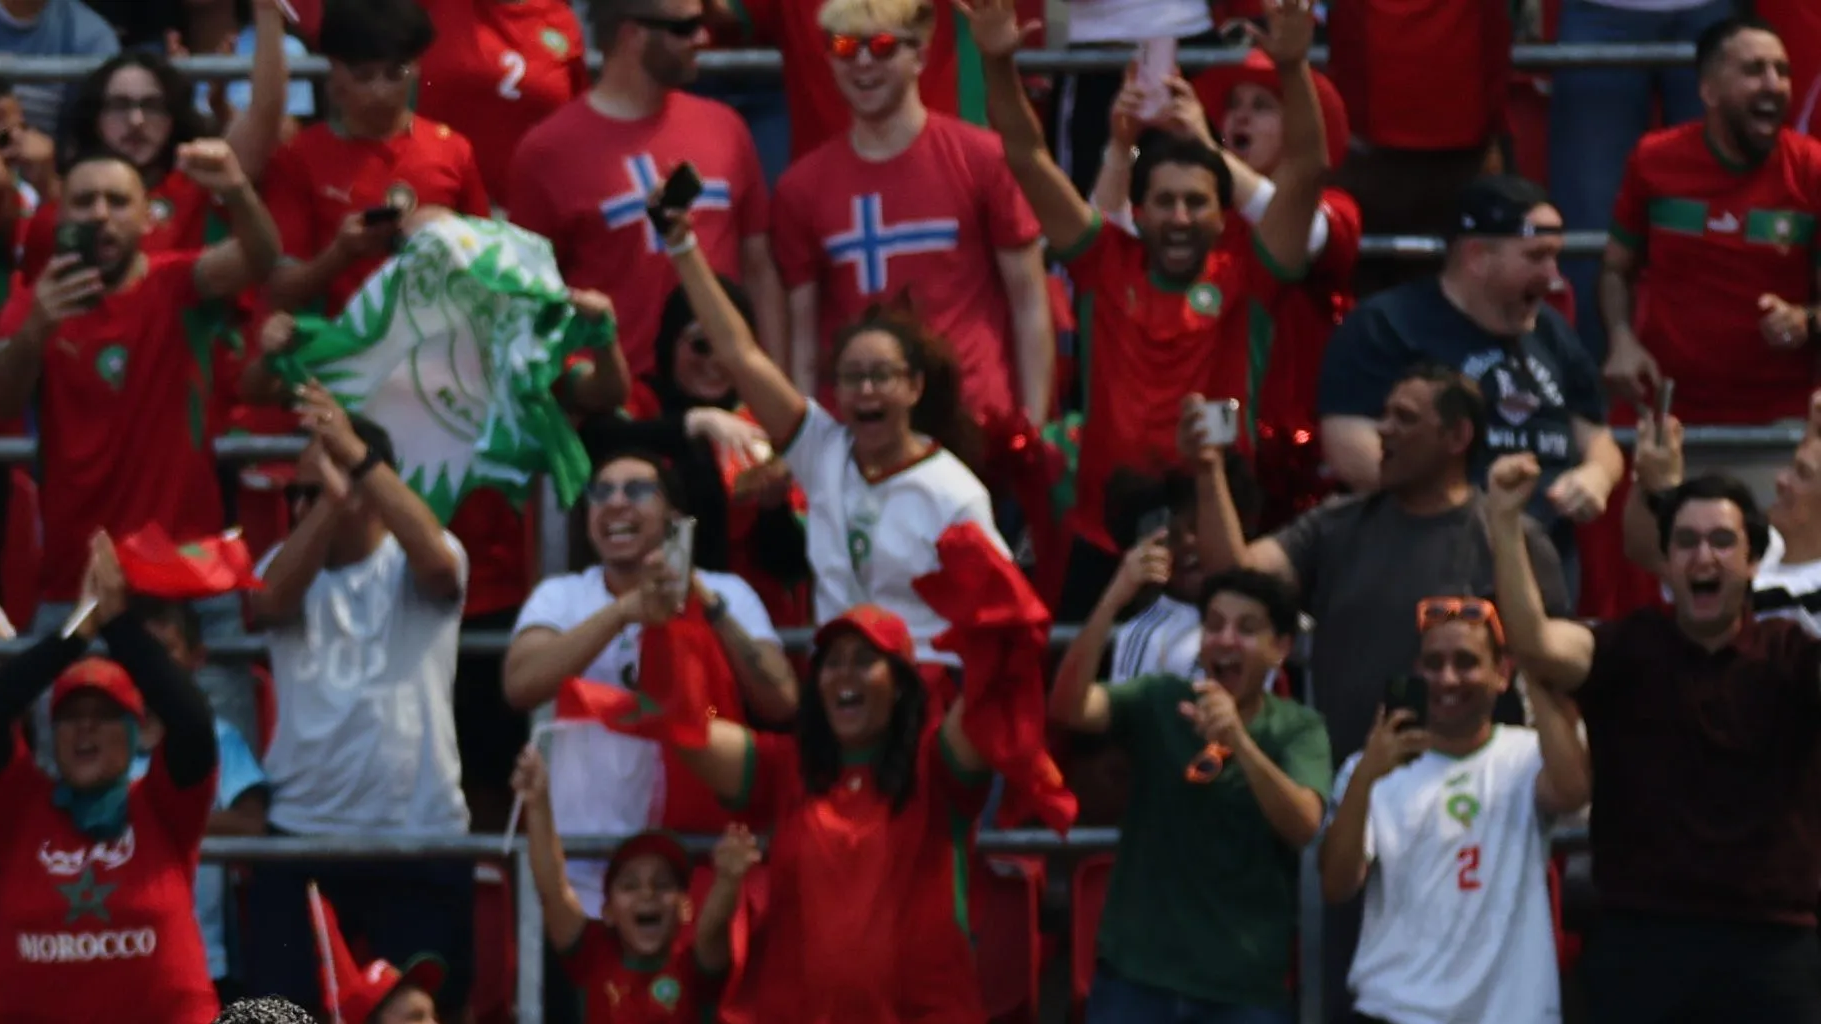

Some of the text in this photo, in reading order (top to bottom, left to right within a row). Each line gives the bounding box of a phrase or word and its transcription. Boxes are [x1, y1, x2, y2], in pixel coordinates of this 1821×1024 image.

[498, 50, 526, 99] 2
[1455, 845, 1483, 891] 2
[17, 929, 157, 963] MOROCCO
